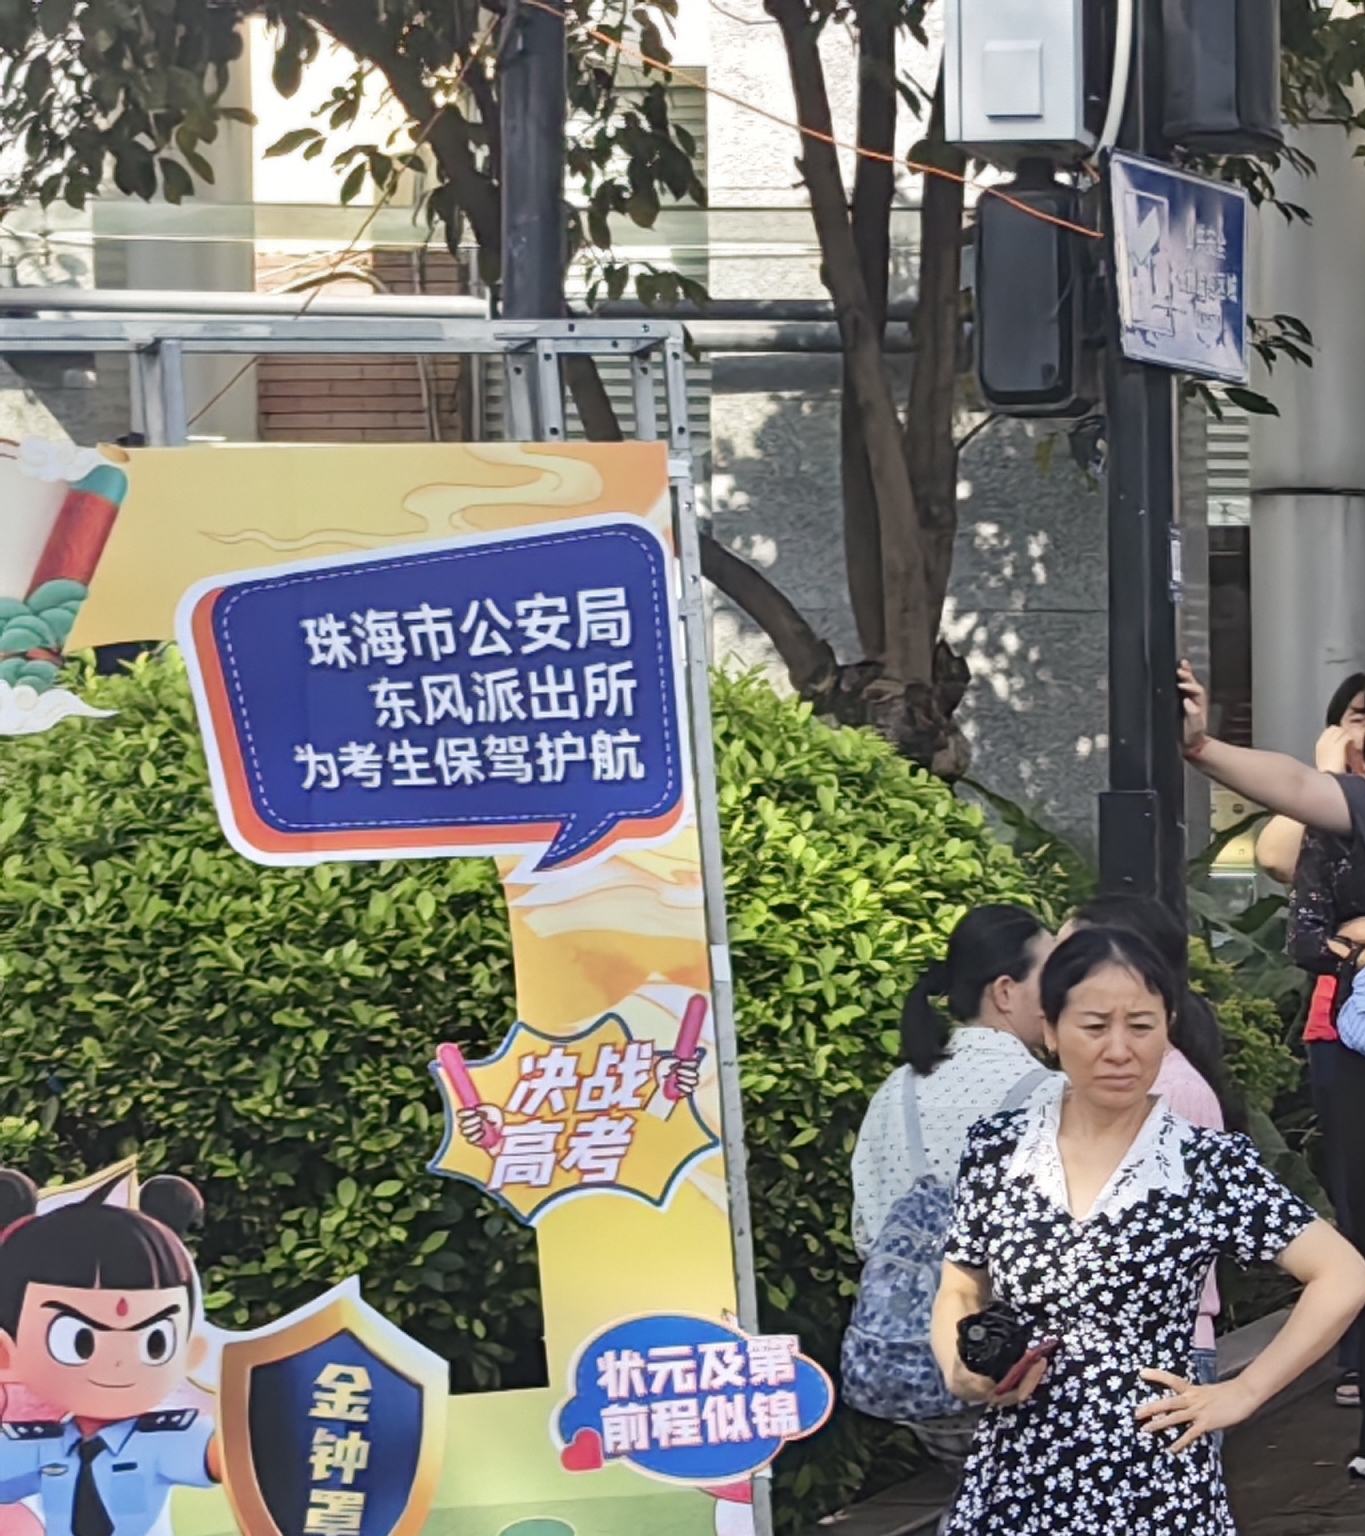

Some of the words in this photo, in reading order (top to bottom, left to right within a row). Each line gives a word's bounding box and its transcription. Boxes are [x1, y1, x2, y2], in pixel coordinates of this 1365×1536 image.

[299, 586, 634, 670] 珠海市公安局
[367, 660, 638, 730] 东风派出所
[293, 728, 646, 791] 为考生保驾护航
[505, 1040, 655, 1116] 决战
[487, 1114, 637, 1191] 高考
[596, 1335, 799, 1400] 状元及第
[600, 1389, 801, 1454] 前程似锦
